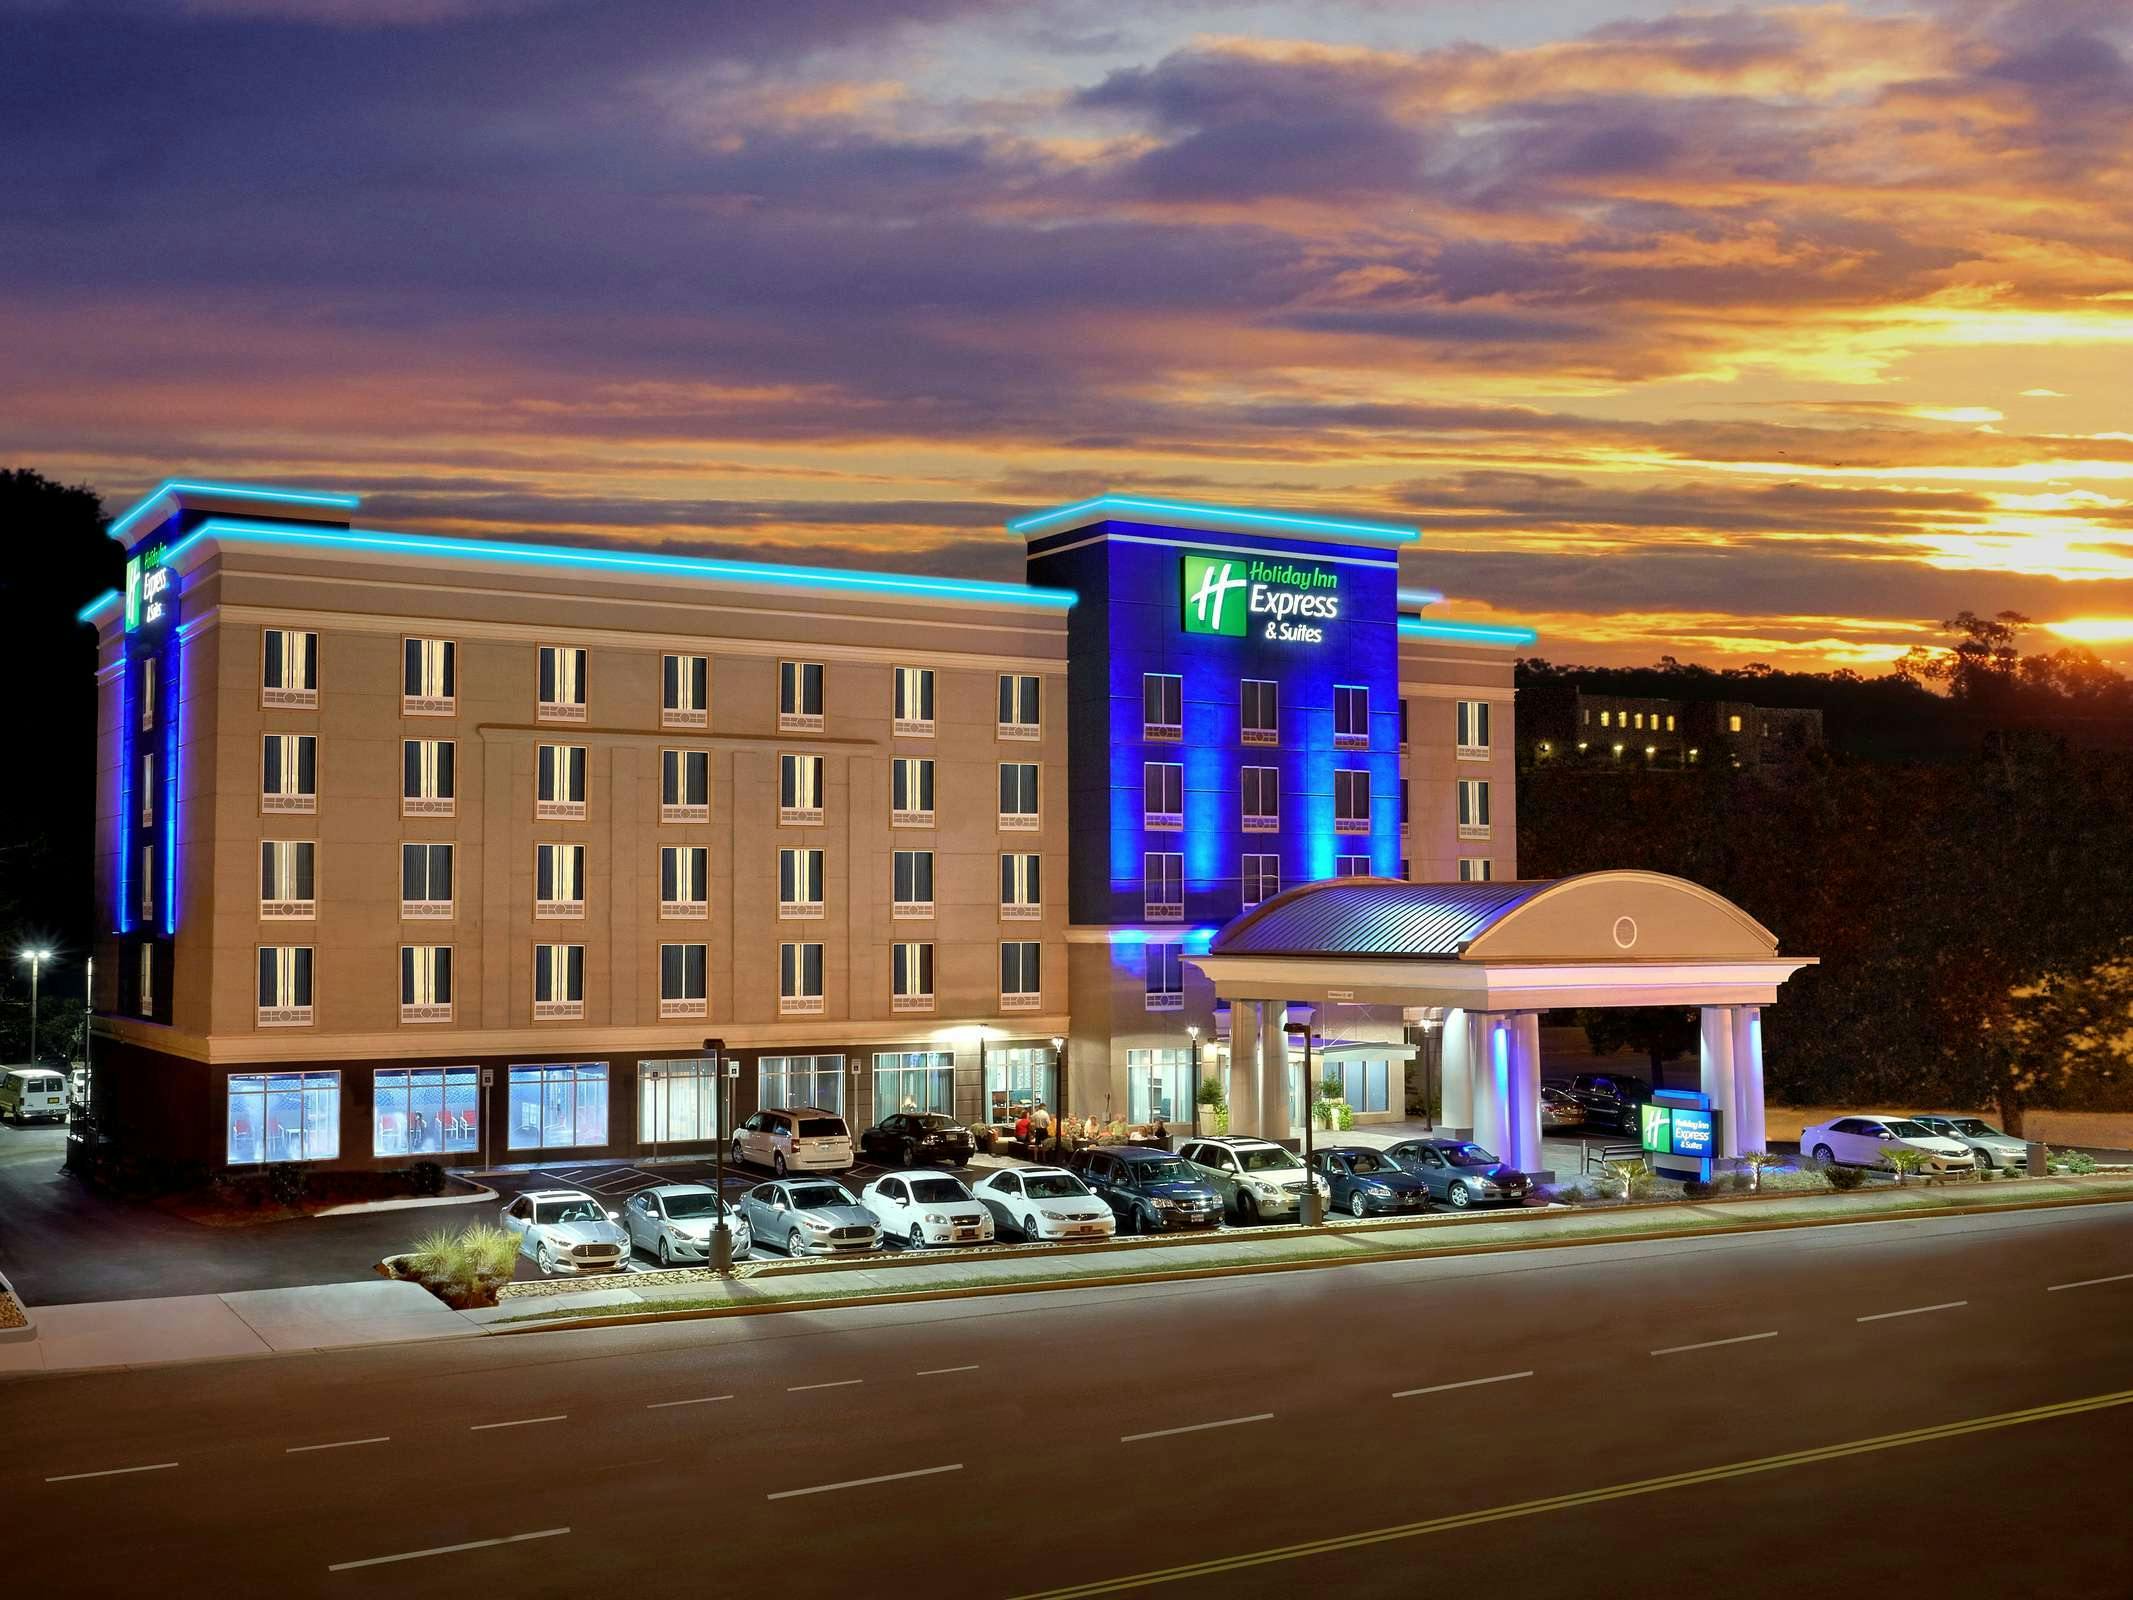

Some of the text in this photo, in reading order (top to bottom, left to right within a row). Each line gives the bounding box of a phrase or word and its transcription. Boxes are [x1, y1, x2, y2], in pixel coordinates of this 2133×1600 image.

[1250, 561, 1338, 590] Holiday Inn
[1250, 584, 1339, 621] Express
[1265, 621, 1322, 643] & Suites
[1675, 1128, 1710, 1141] Express
[1686, 1141, 1702, 1150] Suites
